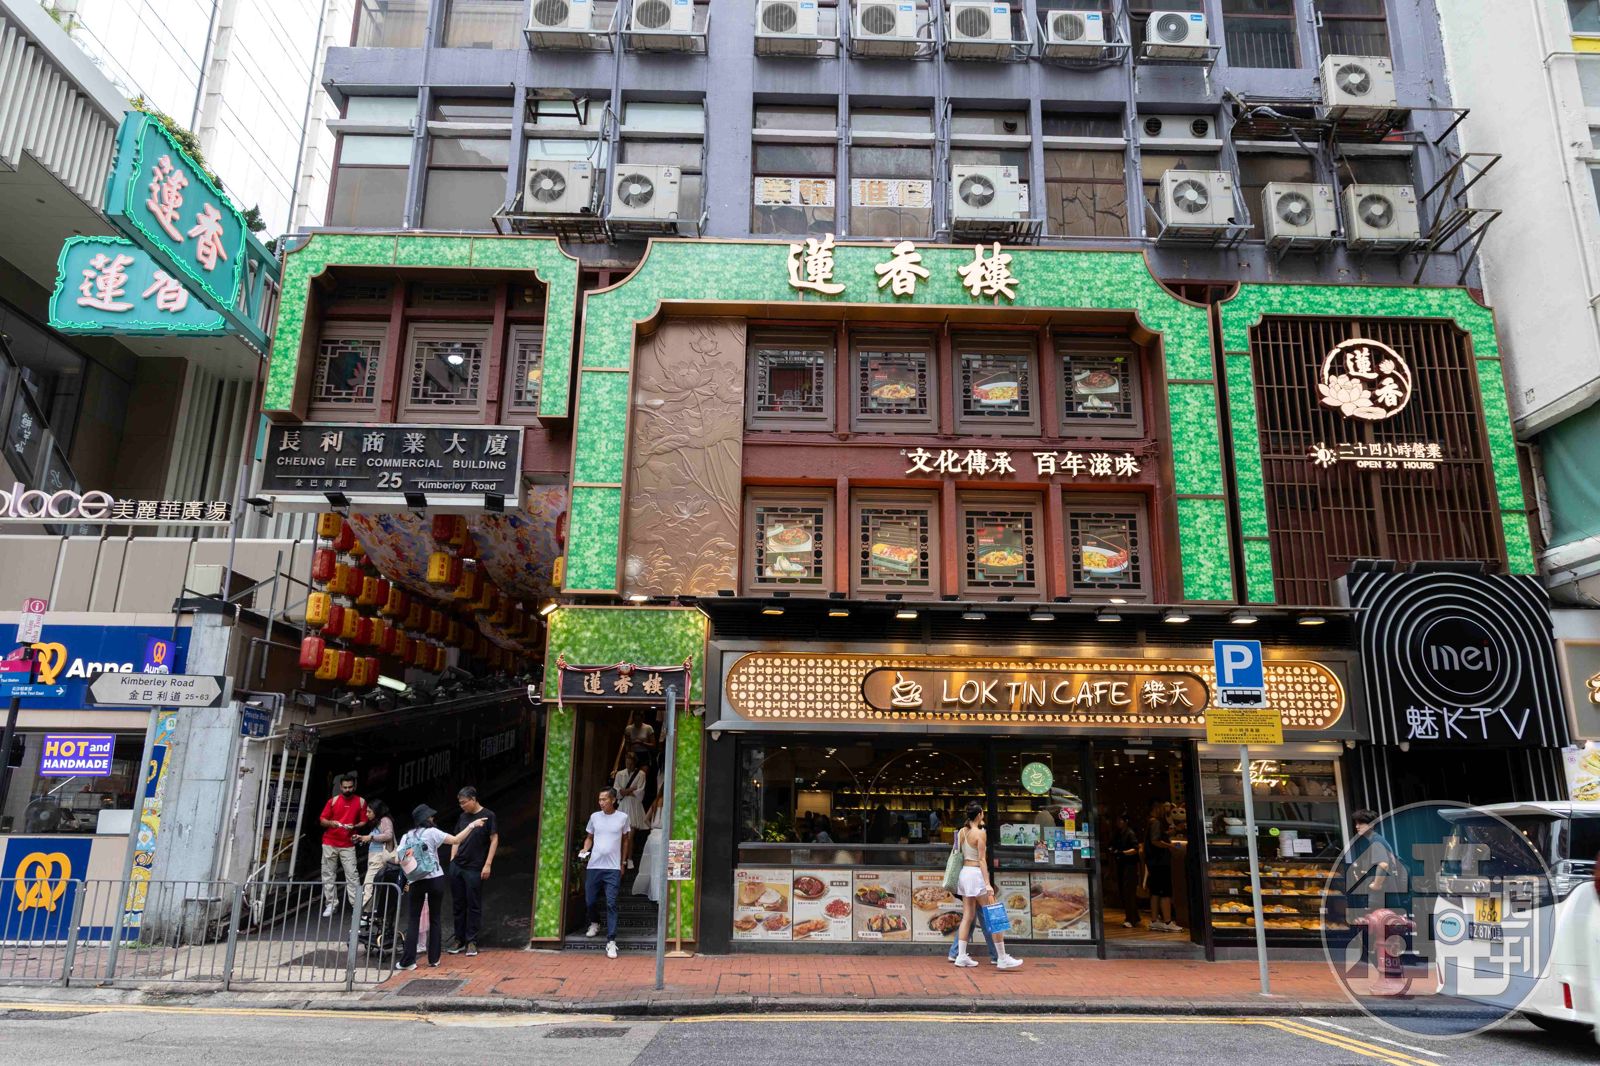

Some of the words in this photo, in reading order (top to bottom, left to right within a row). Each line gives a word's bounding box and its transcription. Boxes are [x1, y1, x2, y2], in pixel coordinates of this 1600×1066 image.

[146, 154, 228, 271] 蓮香
[787, 232, 1020, 300] 蓮香樓
[1346, 347, 1404, 406] 蓮香
[279, 430, 509, 456] 長利商業大廈
[1339, 442, 1443, 458] 二十四小時營業
[276, 457, 325, 466] CHEUNG
[335, 457, 357, 467] LEE
[366, 458, 443, 469] COMMERCIAL
[452, 459, 507, 470] BUILDING
[905, 447, 1017, 475] 文化傳承
[1033, 450, 1142, 477] 百年滋味
[1357, 460, 1382, 469] OPEN
[1386, 461, 1398, 469] 24
[1403, 461, 1436, 470] HOURS
[377, 471, 402, 488] 25
[418, 480, 466, 492] Kimberley
[471, 481, 497, 491] Road
[112, 499, 229, 521] 美麗華廣場
[1222, 644, 1253, 684] P
[1430, 640, 1492, 671] mei
[121, 677, 167, 687] Kimberley
[170, 678, 195, 687] Road
[583, 671, 664, 695] 蓮香樓
[129, 690, 181, 702] 金巴利道
[943, 679, 998, 704] LOK
[1006, 680, 1046, 707] TIN
[1052, 680, 1132, 707] CAFE
[1143, 680, 1194, 709] 樂天
[45, 741, 88, 757] HOT
[89, 743, 110, 752] and
[43, 759, 109, 769] HANDMADE
